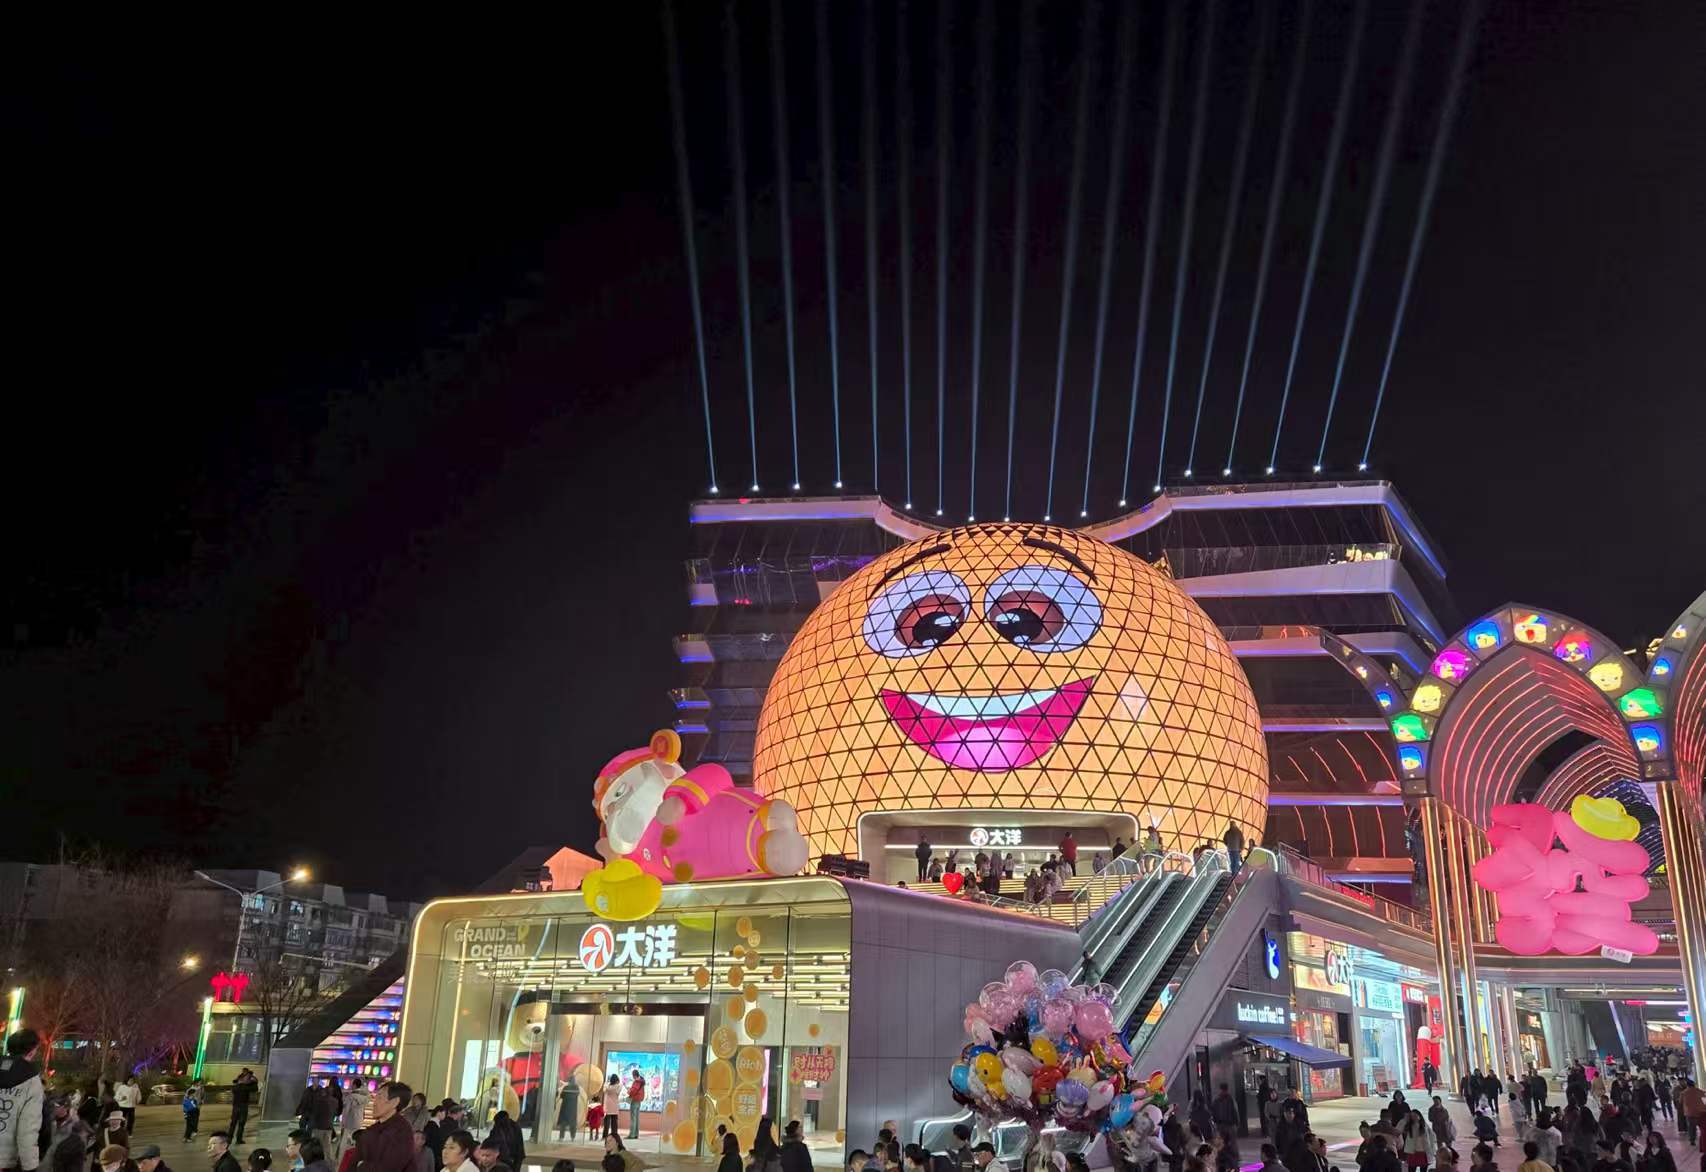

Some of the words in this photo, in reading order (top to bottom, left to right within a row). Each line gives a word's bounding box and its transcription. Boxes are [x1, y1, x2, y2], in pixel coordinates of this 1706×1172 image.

[989, 828, 1022, 845] 大洋
[454, 927, 506, 943] GRAND
[470, 943, 526, 958] OCEAN
[614, 924, 677, 967] 大洋
